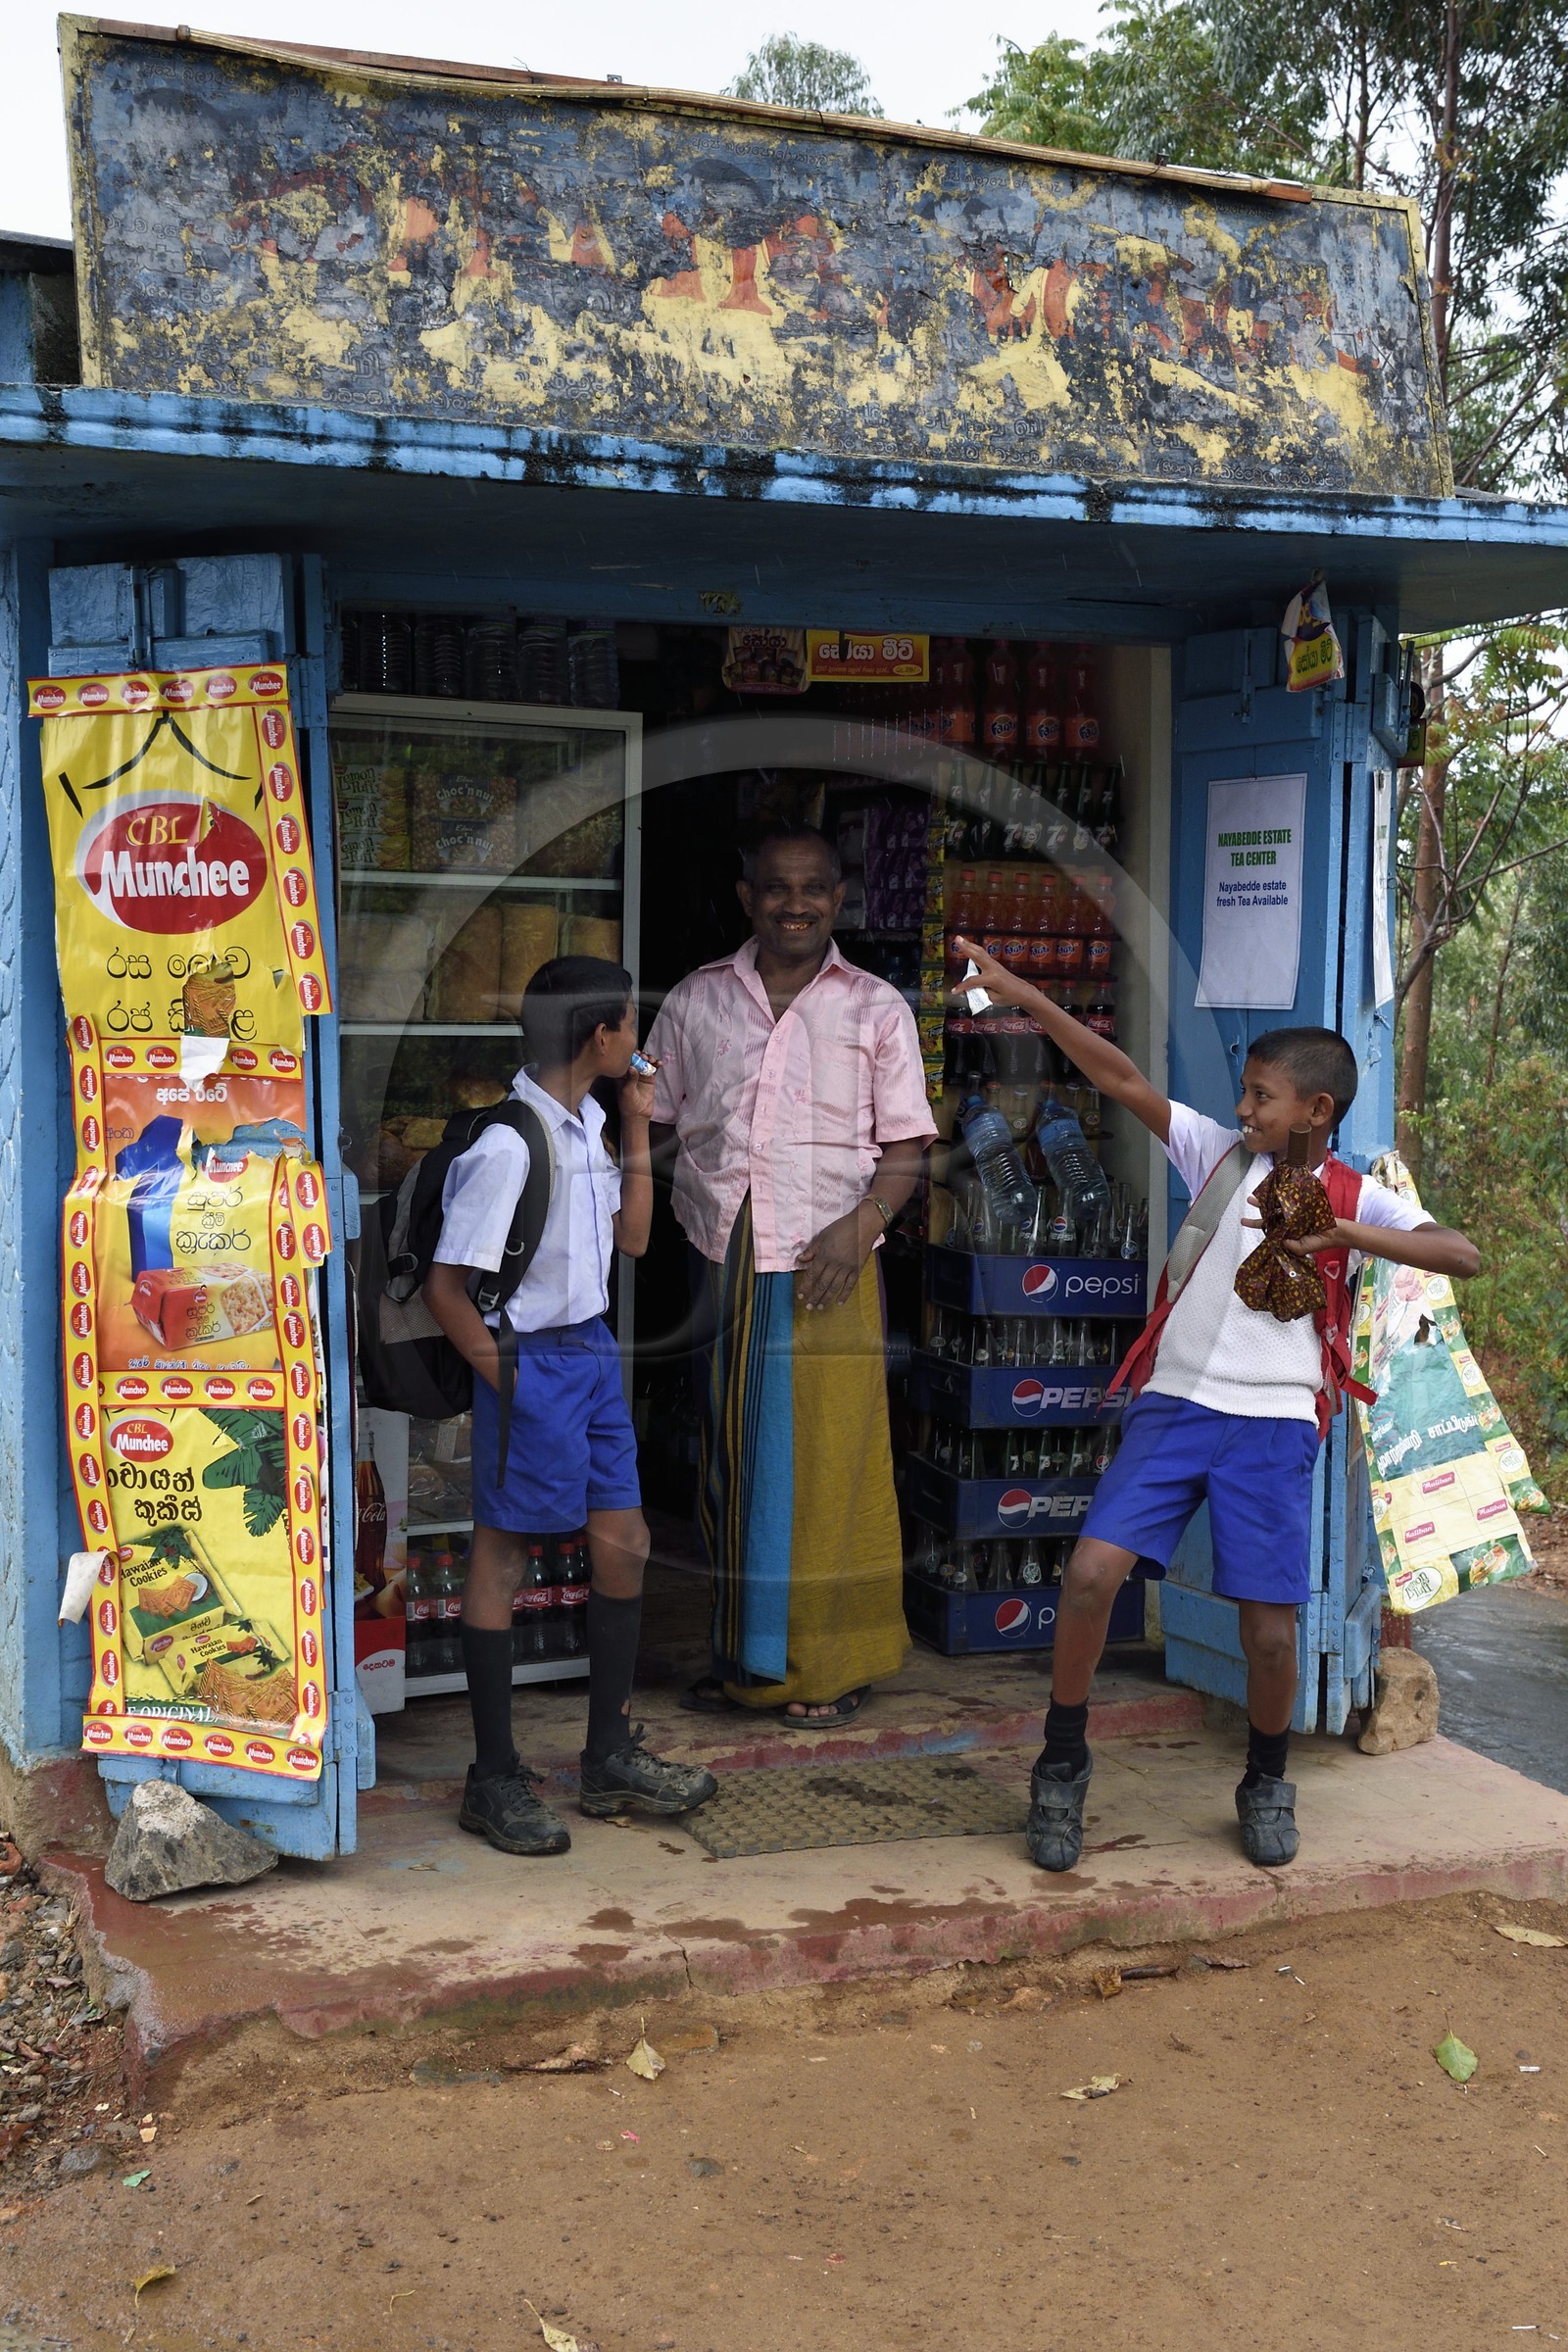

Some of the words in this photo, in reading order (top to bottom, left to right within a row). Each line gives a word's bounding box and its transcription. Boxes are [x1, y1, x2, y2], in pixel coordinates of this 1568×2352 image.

[165, 687, 192, 698] Munchee
[208, 682, 235, 695] Munchee
[252, 680, 281, 693] Munchee
[37, 694, 64, 705] Munchee
[80, 692, 108, 703] Munchee
[124, 688, 148, 700] Munchee
[267, 714, 276, 747] Munchee
[274, 766, 284, 799] Munchee
[126, 815, 188, 847] CBL
[281, 819, 291, 852] Munchee
[1218, 831, 1261, 847] NAYABEDDE
[1263, 829, 1292, 845] ESTATE
[341, 837, 374, 854] emon
[1231, 853, 1244, 866] TEA
[1247, 851, 1276, 865] CENTER
[100, 847, 249, 898] Munchee
[288, 872, 299, 905] Munchee
[1219, 880, 1260, 894] Nayabedde
[1263, 880, 1287, 890] estate
[1217, 896, 1235, 906] fresh
[1238, 896, 1250, 906] Tea
[1252, 895, 1288, 906] Available
[296, 925, 306, 956] Munchee
[107, 947, 152, 979] රස
[303, 977, 313, 1009] Munchee
[107, 1001, 153, 1032] රජ
[80, 1017, 90, 1050] Munchee
[109, 1054, 133, 1064] Munchee
[149, 1054, 175, 1063] Munchee
[231, 1057, 256, 1066] Munchee
[272, 1058, 296, 1068] Munchee
[1065, 1273, 1140, 1299] pepsi
[79, 1304, 88, 1334] Munchee
[120, 1386, 146, 1395] Munchee
[165, 1386, 191, 1395] Munchee
[209, 1386, 233, 1395] Munchee
[250, 1387, 273, 1396] Munchee
[126, 1423, 148, 1433] CBL
[117, 1435, 169, 1452] Munchee
[86, 1456, 96, 1483] Munchee
[95, 1502, 106, 1529] Munchee
[129, 1567, 168, 1588] Cookies
[190, 1639, 221, 1654] Hawaian
[200, 1644, 225, 1658] Cookies
[84, 1729, 111, 1740] Munchee
[127, 1732, 151, 1742] Munchee
[164, 1735, 191, 1746] Munchee
[207, 1740, 233, 1752] Munchee
[247, 1748, 272, 1760] Munchee
[290, 1755, 317, 1767] Munchee
